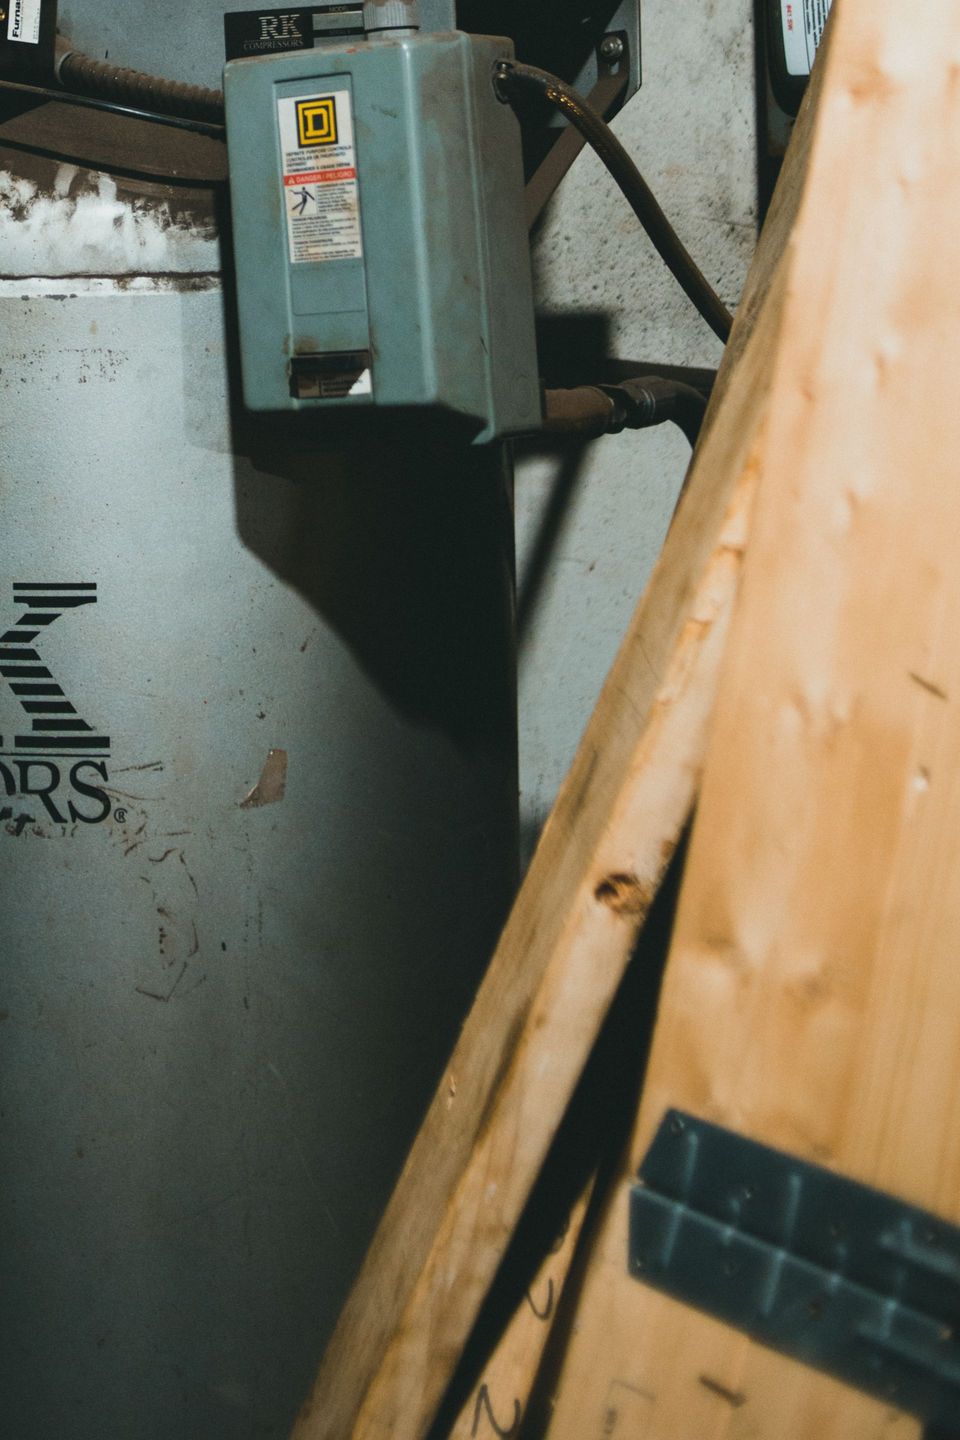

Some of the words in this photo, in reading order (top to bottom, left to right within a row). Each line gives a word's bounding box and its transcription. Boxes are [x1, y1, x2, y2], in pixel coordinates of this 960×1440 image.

[258, 14, 303, 40] RK
[242, 39, 305, 50] COMPRESSORS
[296, 174, 322, 184] DANGER
